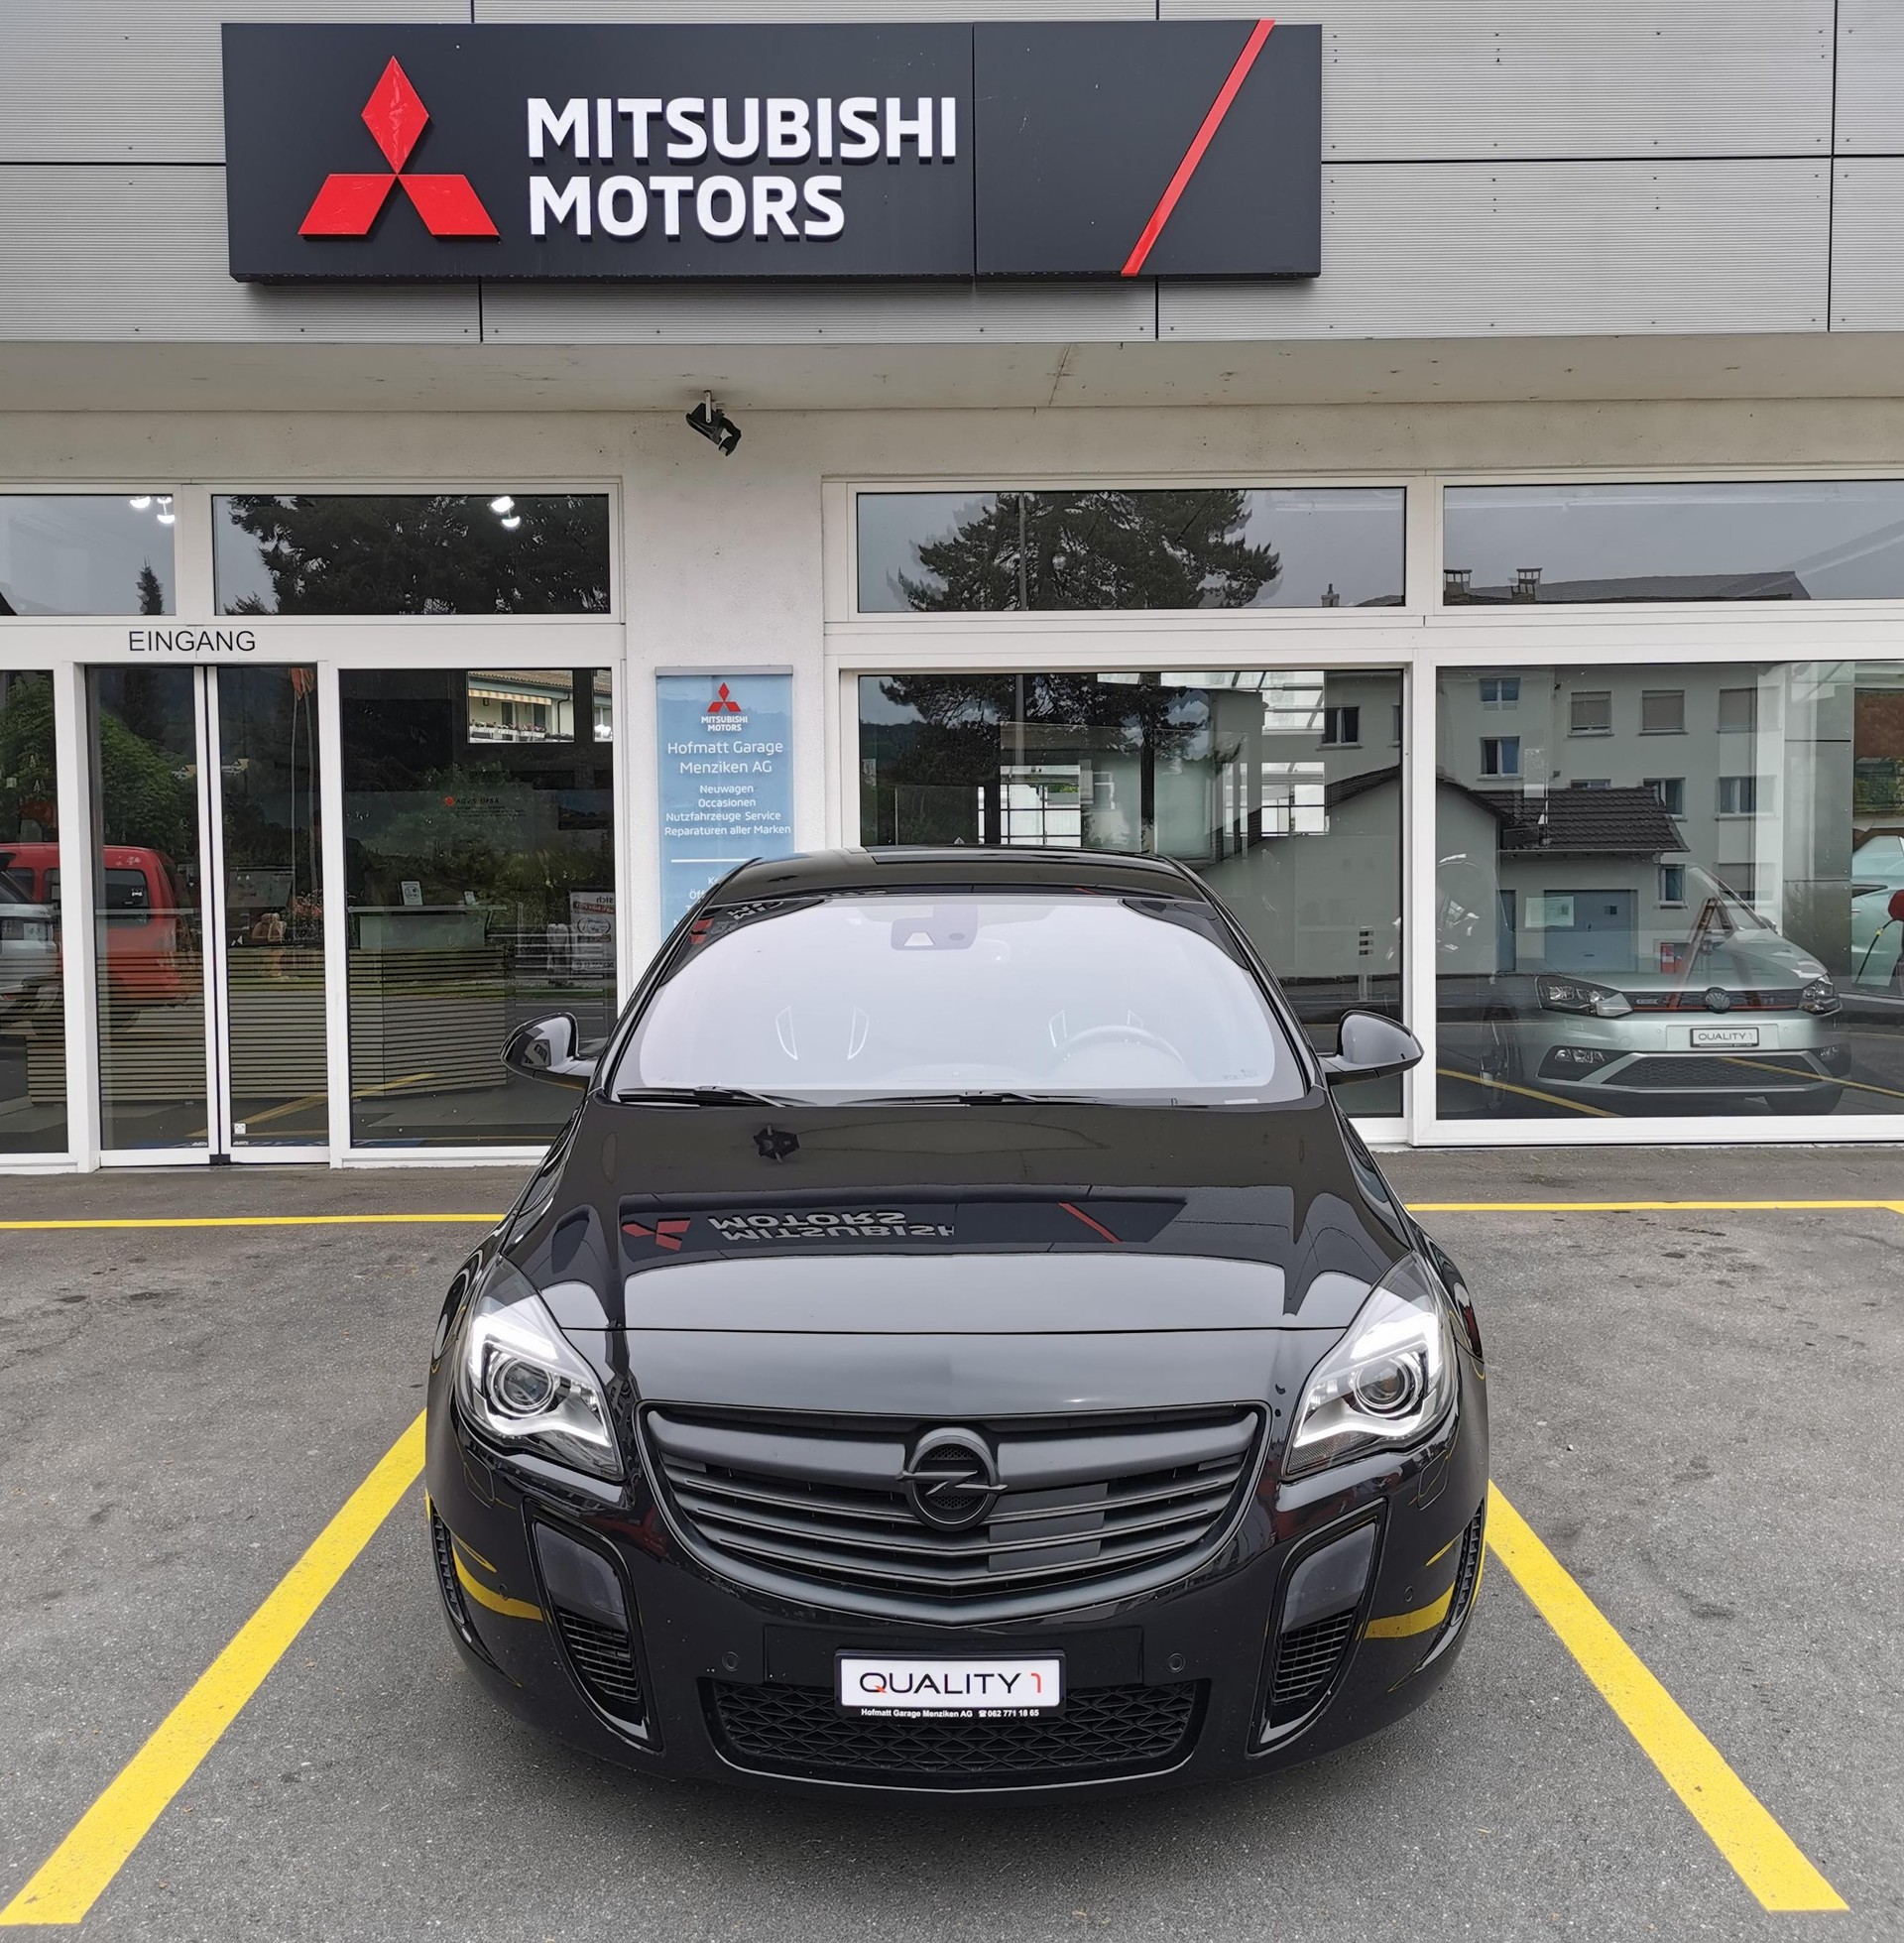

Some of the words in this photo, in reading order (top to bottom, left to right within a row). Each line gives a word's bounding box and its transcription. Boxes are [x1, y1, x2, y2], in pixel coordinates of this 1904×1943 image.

[528, 97, 957, 162] MITSUBISHI
[530, 175, 846, 239] MOTORS
[129, 630, 256, 652] EINGANG
[700, 715, 749, 724] MITSUBISHI
[707, 723, 743, 732] MOTORS
[667, 740, 729, 755] Hofmatt
[733, 741, 783, 757] Garage
[679, 761, 749, 774] Menziken
[752, 760, 773, 773] AG
[699, 784, 754, 795] Neuwagen
[698, 798, 756, 808] Occasionen
[665, 810, 742, 823] Nutzfahrzeuge
[745, 810, 781, 821] Service
[664, 826, 728, 837] Reparaturen
[730, 825, 751, 835] aller
[754, 825, 791, 835] Marken
[860, 1672, 1021, 1694] QUALITY
[1030, 1672, 1042, 1693] 1
[861, 1708, 892, 1717] Hofmatt
[892, 1709, 921, 1719] Garage
[922, 1709, 959, 1718] Menziken
